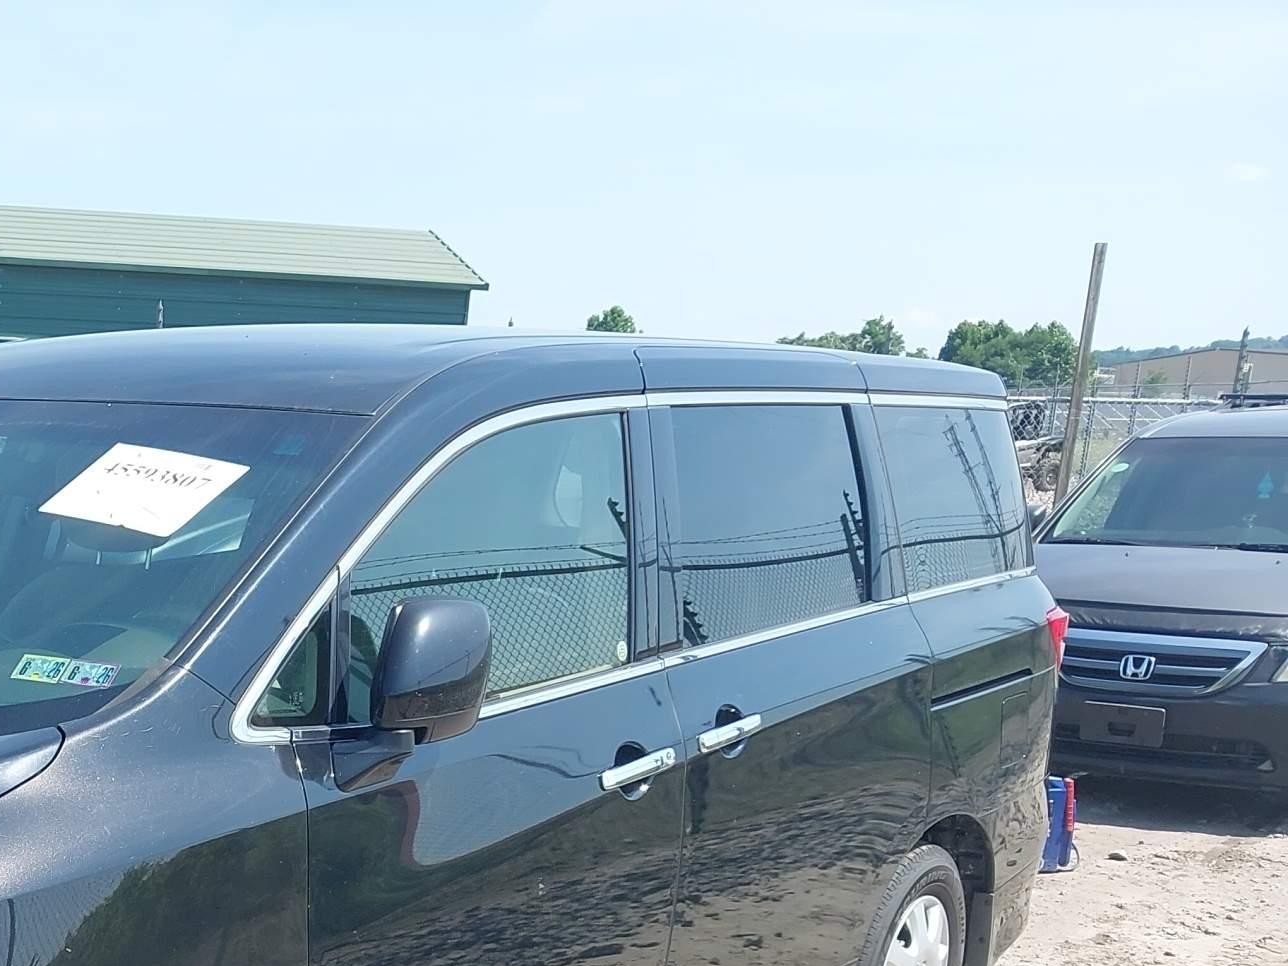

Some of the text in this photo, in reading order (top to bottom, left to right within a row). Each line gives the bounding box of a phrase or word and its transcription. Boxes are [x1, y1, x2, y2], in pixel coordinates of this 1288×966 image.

[103, 462, 213, 490] 45593807
[19, 661, 65, 678] 6 26
[68, 666, 114, 684] 6 26
